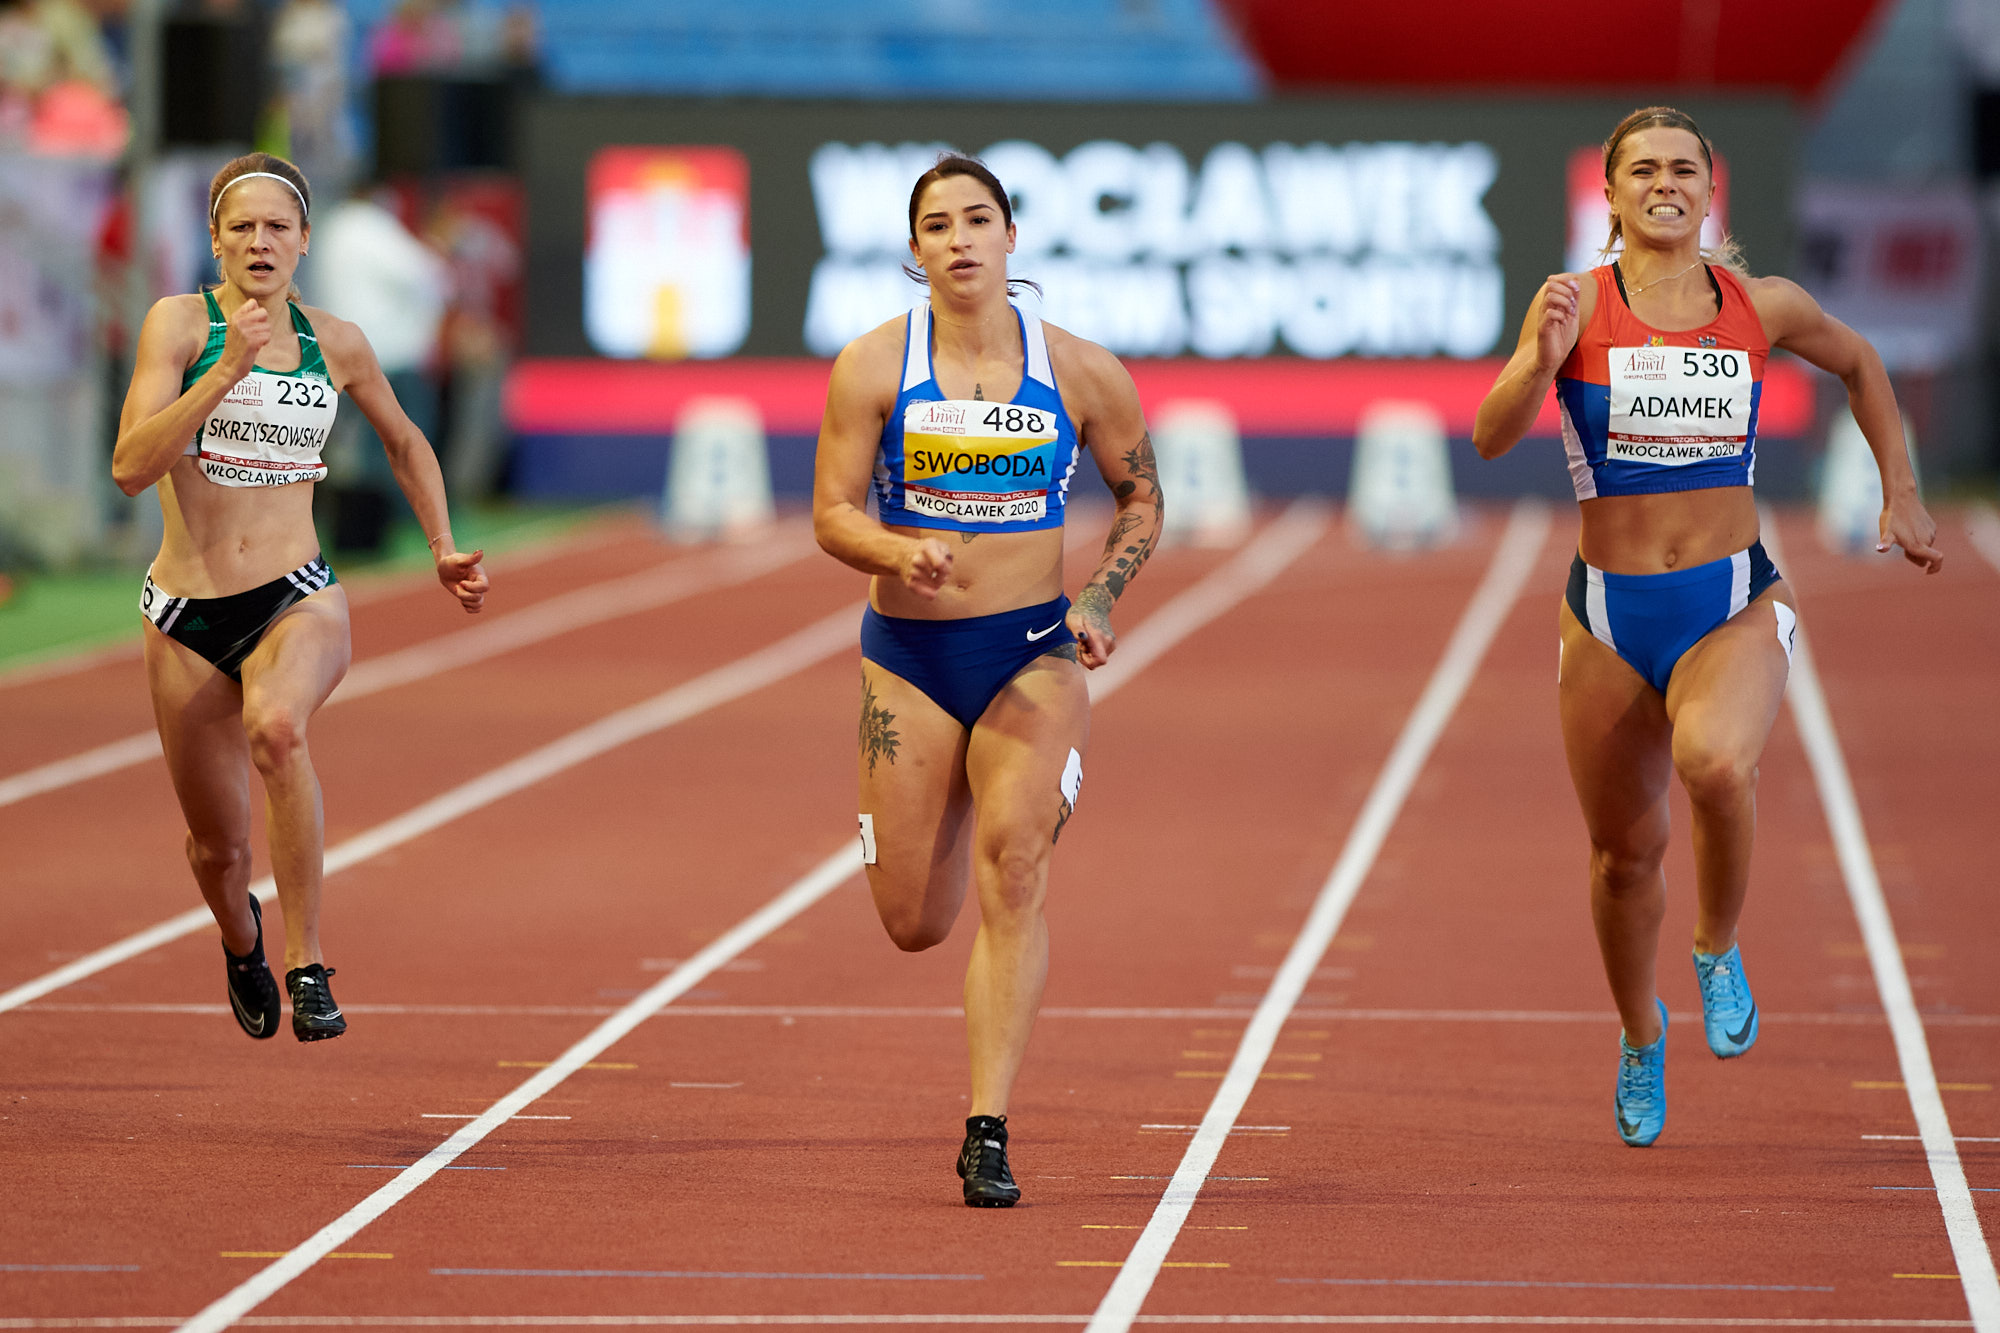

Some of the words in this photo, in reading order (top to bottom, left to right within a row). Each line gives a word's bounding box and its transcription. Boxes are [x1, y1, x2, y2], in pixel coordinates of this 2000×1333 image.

[1624, 352, 1666, 372] Anwil
[1683, 352, 1739, 378] 530
[277, 380, 328, 409] 232
[921, 406, 966, 425] Anwil
[1629, 396, 1733, 419] ADAMEK
[208, 418, 325, 448] SKRZYSZOWSKA
[224, 456, 246, 466] PZLA
[1616, 443, 1704, 458] WŁOCŁAWEK
[1708, 444, 1735, 457] 2020
[206, 463, 290, 485] WŁOCŁAWEK
[913, 450, 1046, 477] SWOBODA
[914, 494, 1005, 517] WŁOCŁAWEK
[1010, 500, 1039, 516] 2020
[951, 492, 1011, 501] MISTRZOSTWA
[1012, 490, 1039, 499] POLSKI
